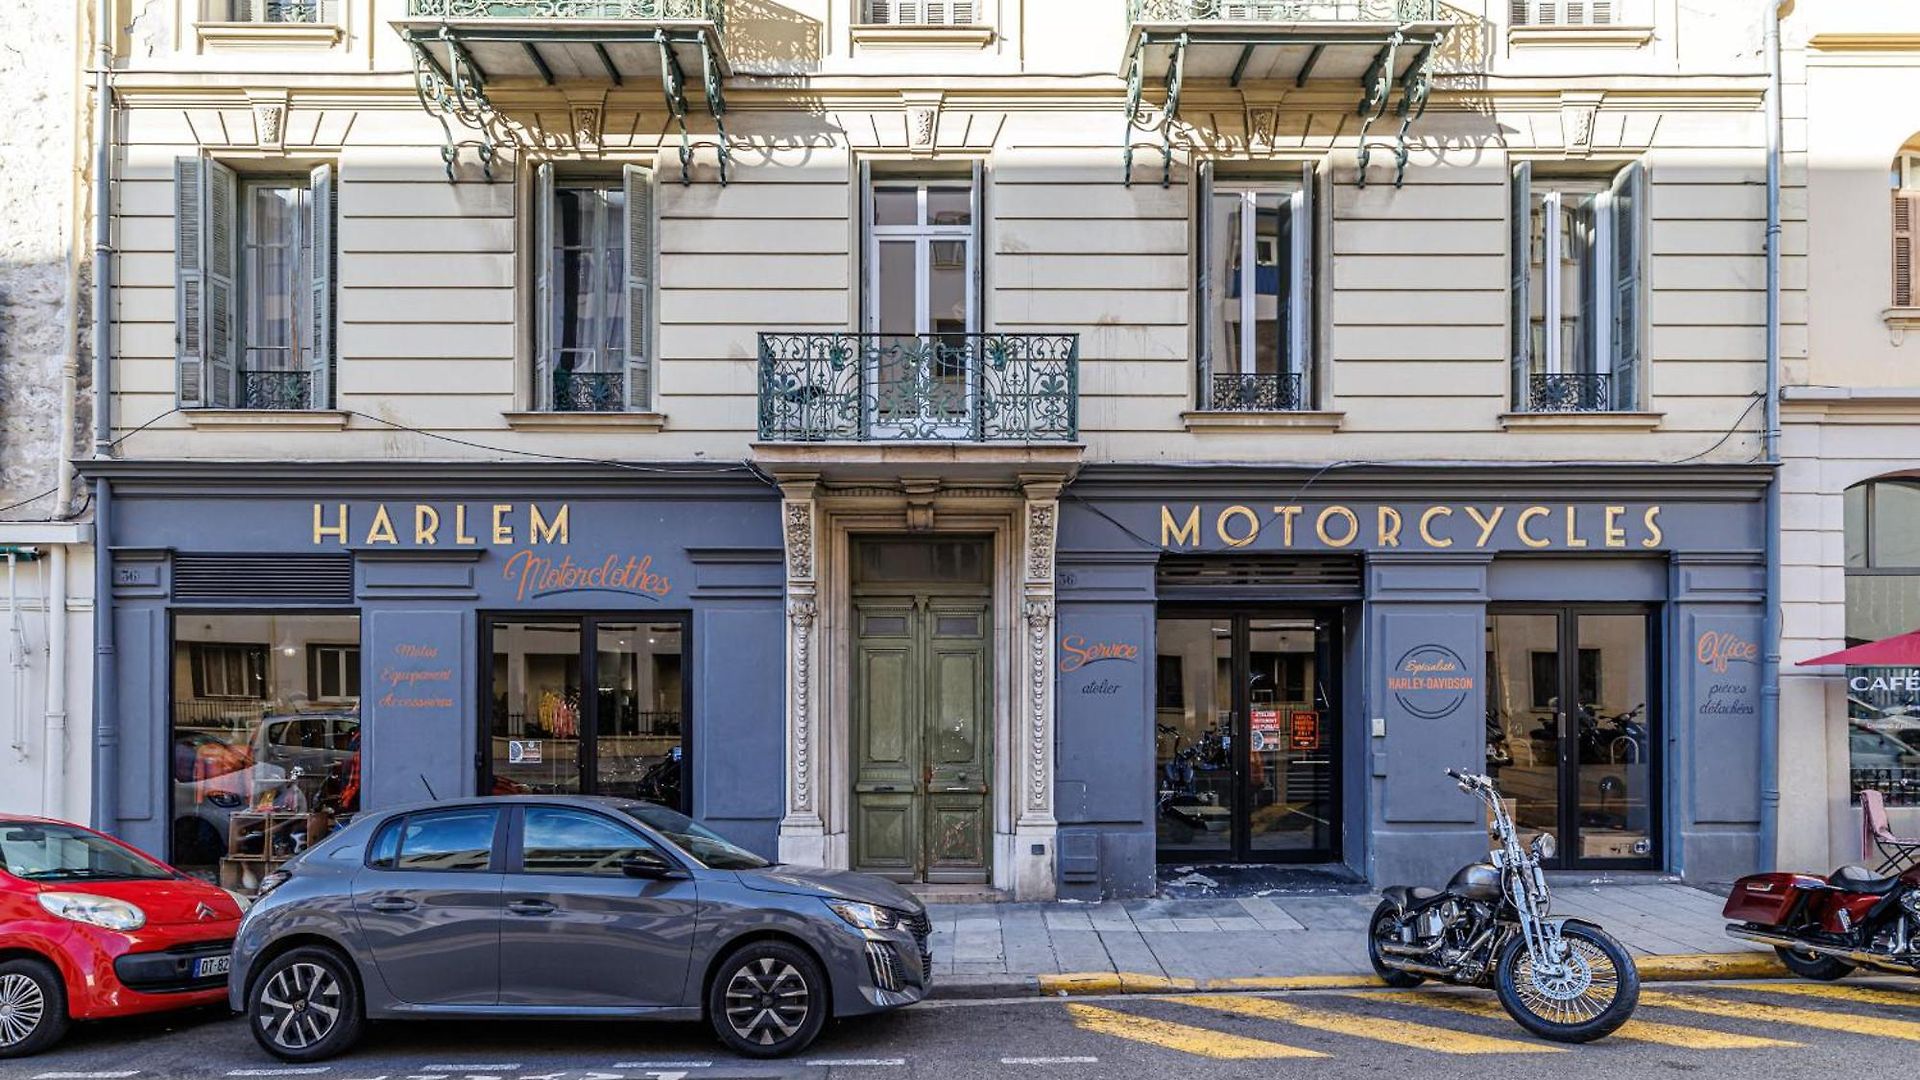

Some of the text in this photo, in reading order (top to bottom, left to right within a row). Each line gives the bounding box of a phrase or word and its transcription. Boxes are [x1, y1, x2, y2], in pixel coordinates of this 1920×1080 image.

[313, 503, 570, 545] HARLEM
[1160, 504, 1664, 548] MOTORCYCLES
[503, 550, 673, 602] Motorclothes
[393, 644, 439, 658] Motos
[1060, 634, 1138, 673] Service
[1697, 630, 1758, 675] Office
[1082, 679, 1123, 694] atelier
[1388, 677, 1473, 689] HARLEY-DAVIDSON
[1850, 670, 1920, 691] CAFÉ
